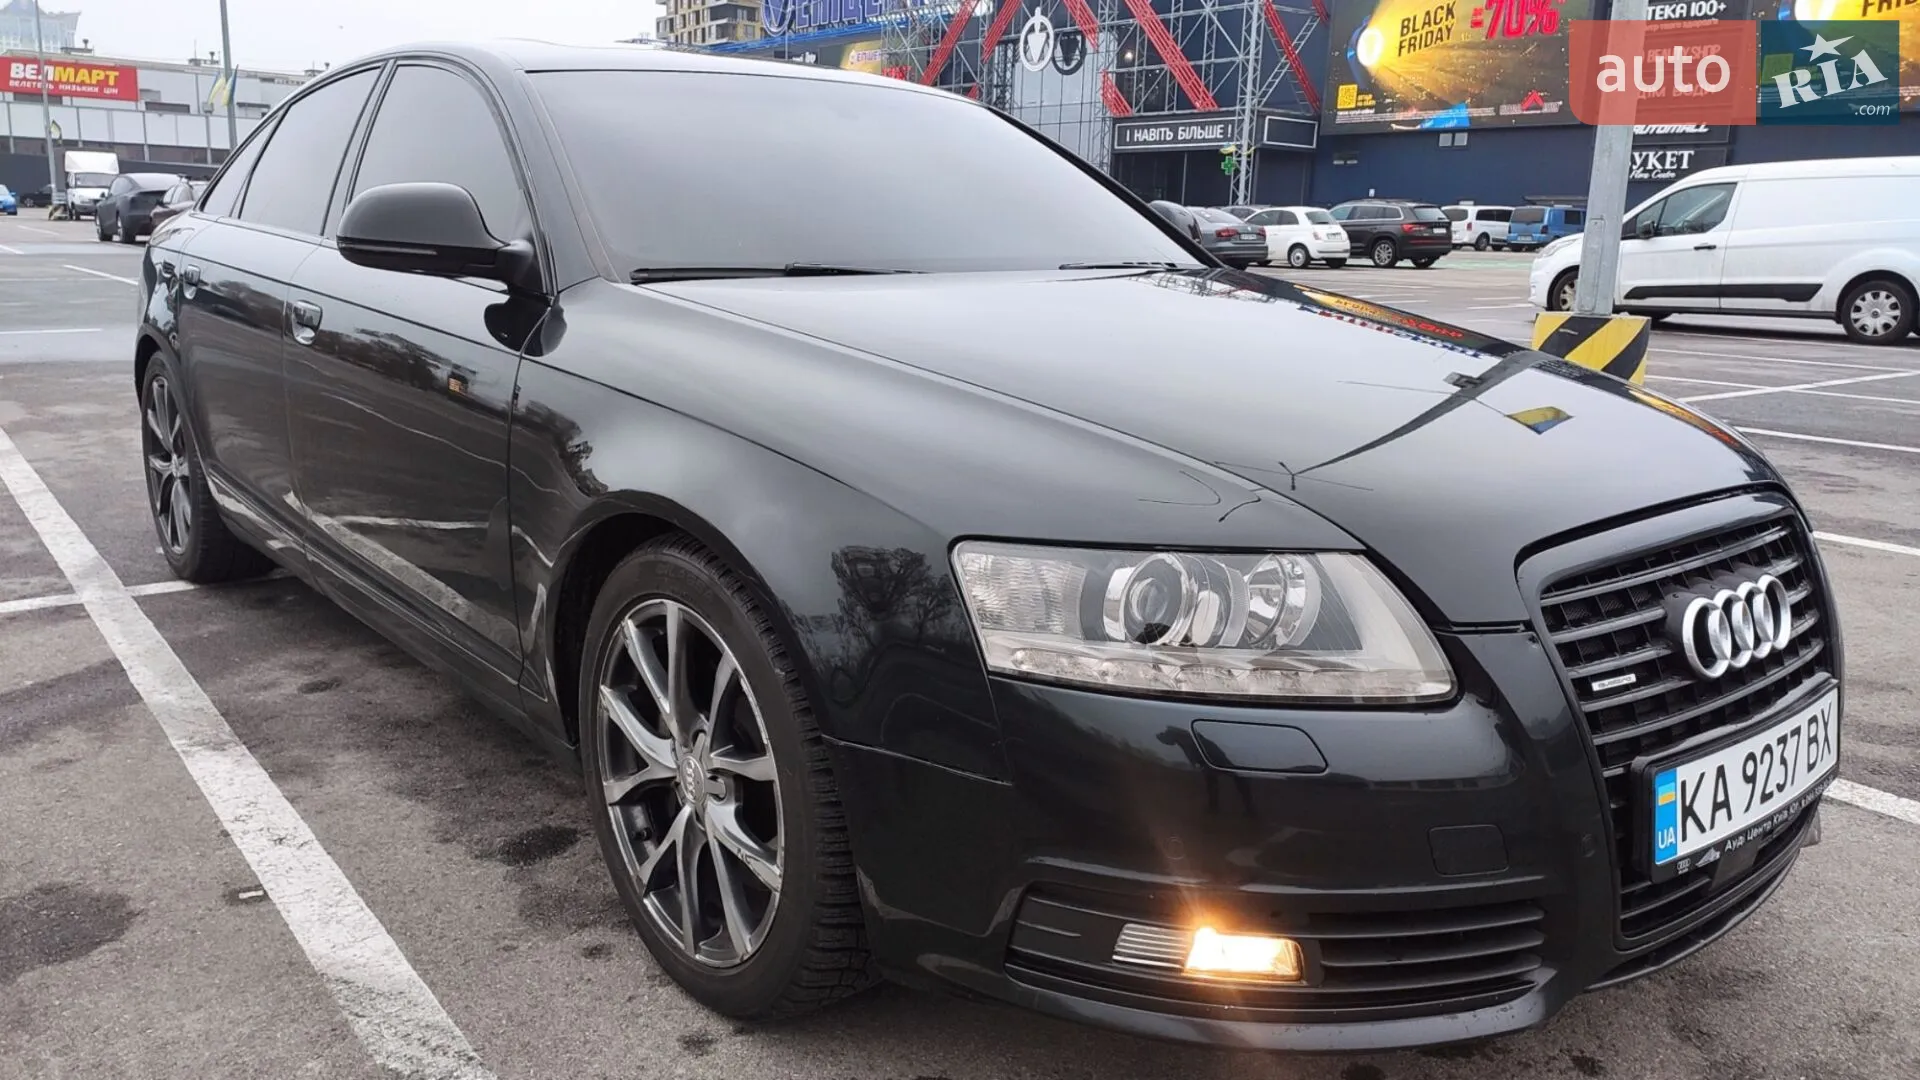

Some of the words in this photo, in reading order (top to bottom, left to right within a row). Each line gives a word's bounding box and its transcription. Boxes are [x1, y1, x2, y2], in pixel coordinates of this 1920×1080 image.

[1647, 3, 1687, 20] ТЕКА
[1690, 0, 1727, 17] 100+
[1861, 0, 1918, 17] FR
[1400, 1, 1456, 37] BLACK
[1398, 23, 1455, 57] FRIDAY
[1647, 46, 1691, 63] BEAUY
[9, 80, 54, 90] ВЕЛЕТЕЬ
[1134, 127, 1174, 142] НАВІТЬ
[1177, 124, 1224, 140] БІЛЬШЕ
[1629, 150, 1695, 170] УКЕТ
[1681, 765, 1733, 843] KA
[1742, 725, 1802, 816] 9237
[1806, 702, 1833, 774] BX
[1658, 827, 1676, 849] UA
